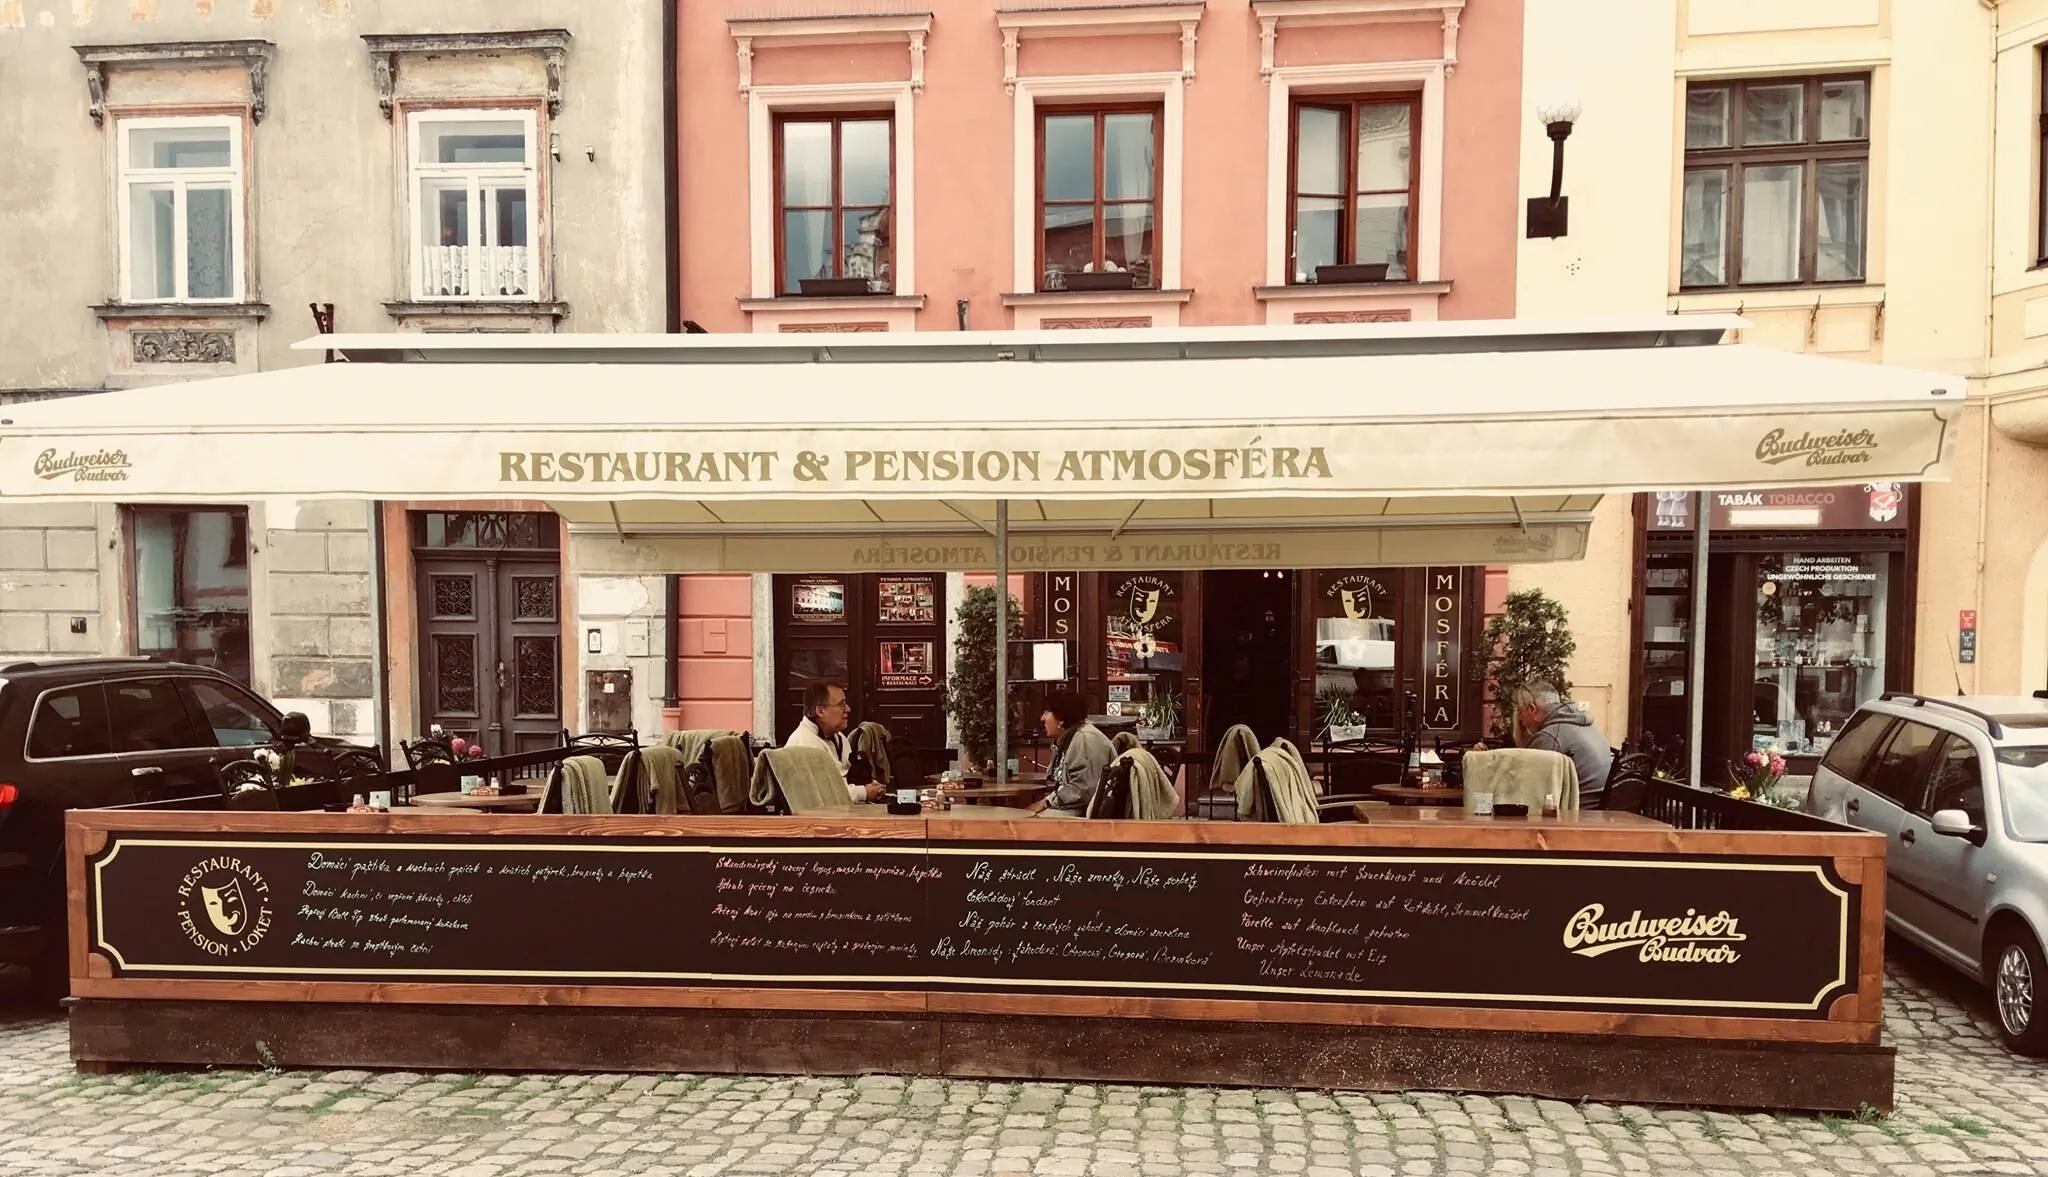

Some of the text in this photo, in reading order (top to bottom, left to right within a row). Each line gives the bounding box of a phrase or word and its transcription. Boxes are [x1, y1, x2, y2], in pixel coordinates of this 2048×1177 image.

[499, 435, 1333, 482] RESTAURANT & PENSION ATMOSFÉRA
[1755, 428, 1878, 461] Budweiser
[1806, 448, 1872, 467] Budvar
[34, 448, 132, 478] Budweiser
[74, 466, 130, 482] Budvar
[1718, 491, 1835, 506] TABÁK TOBACCO
[1116, 576, 1174, 597] RESTAURANT
[1327, 575, 1387, 597] RESTAURANT
[178, 856, 269, 897] RESTAURANT
[178, 910, 228, 956] PENSION
[240, 906, 273, 952] LOKET
[1563, 902, 1747, 951] Budweiser
[1639, 935, 1741, 963] Budvar
